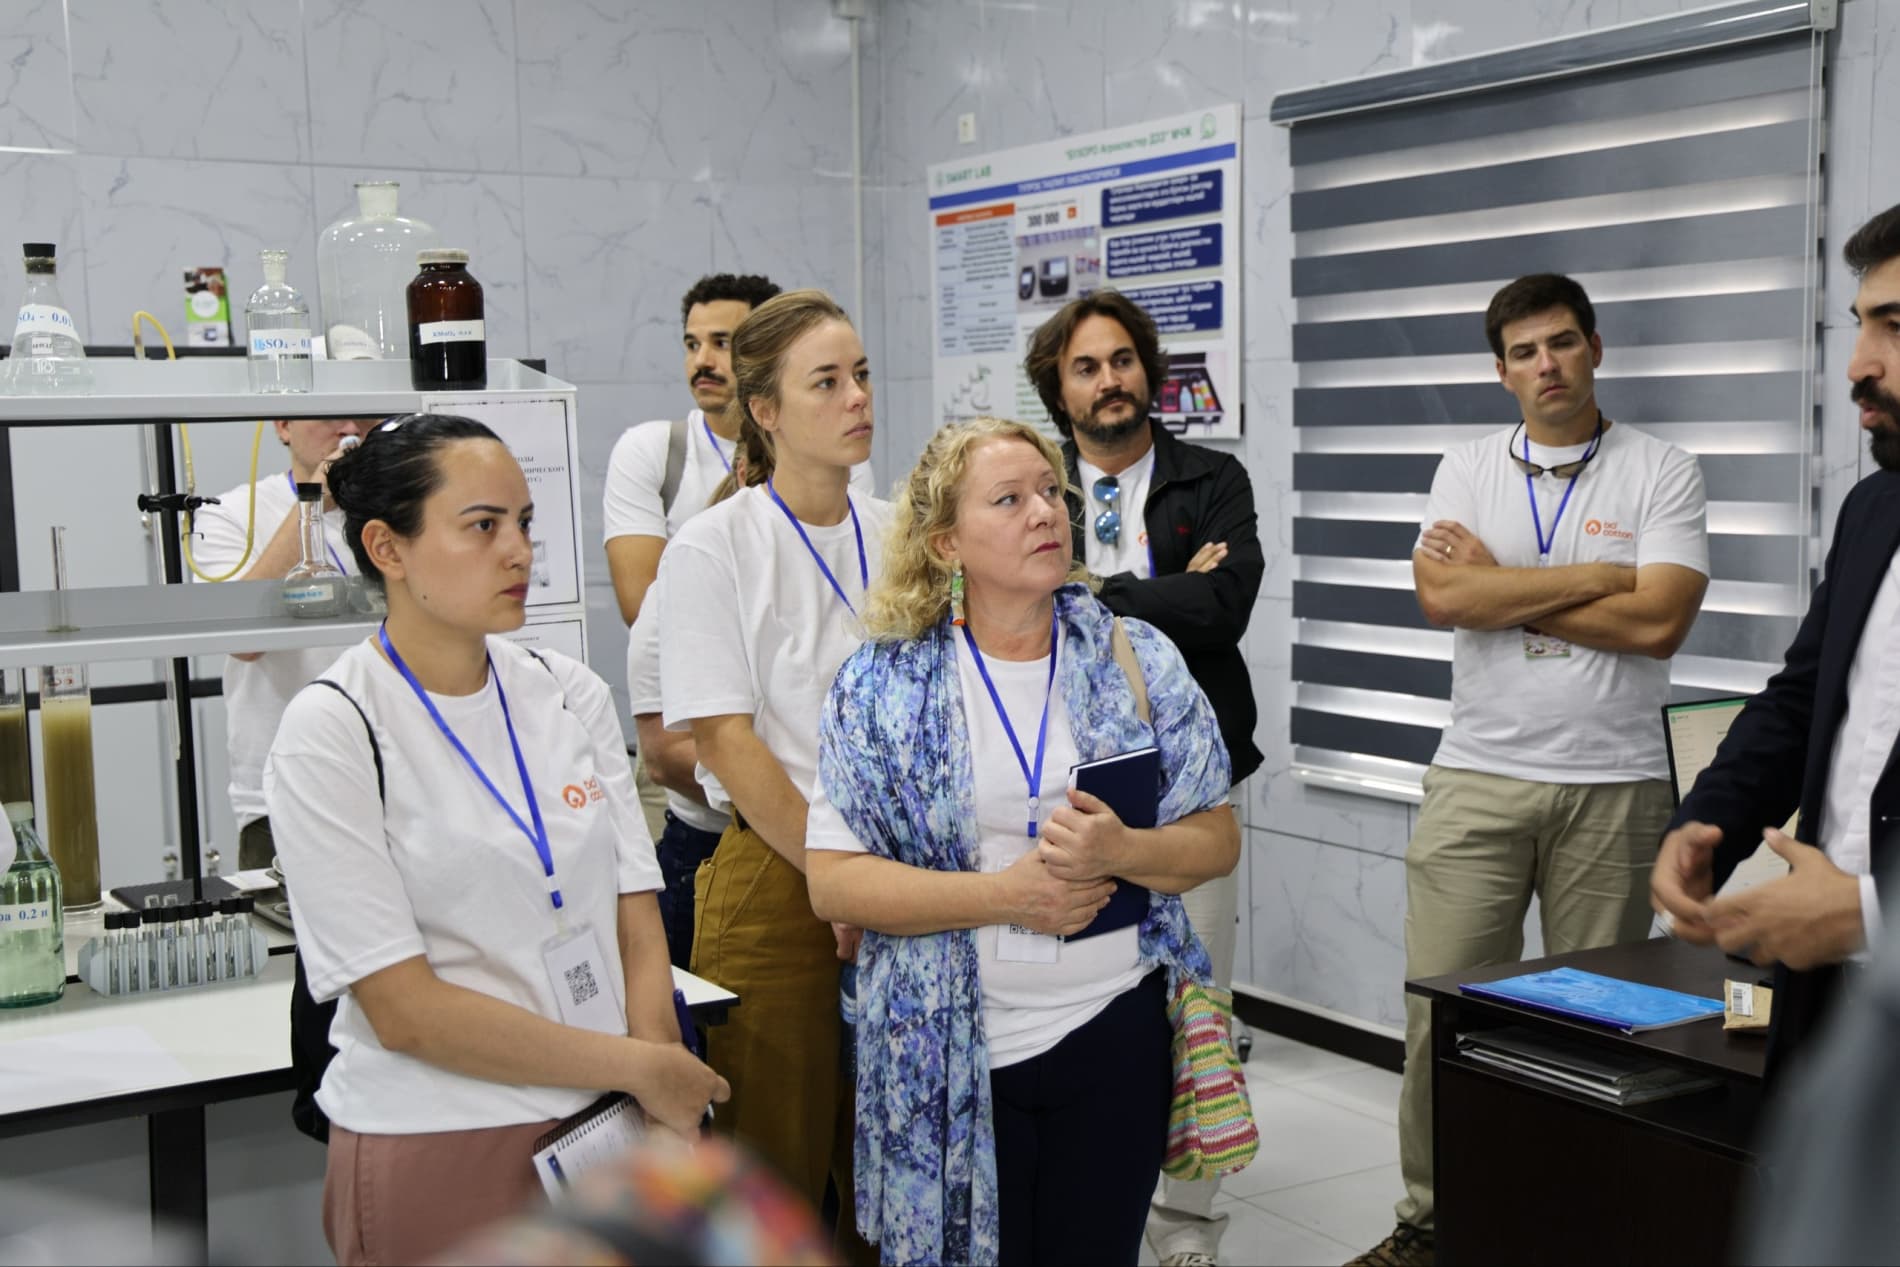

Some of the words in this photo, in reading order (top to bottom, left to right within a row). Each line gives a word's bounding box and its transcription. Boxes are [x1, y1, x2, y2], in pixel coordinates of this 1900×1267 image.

[975, 165, 992, 180] LAB
[1602, 529, 1632, 539] cotton
[19, 908, 38, 920] 0.2
